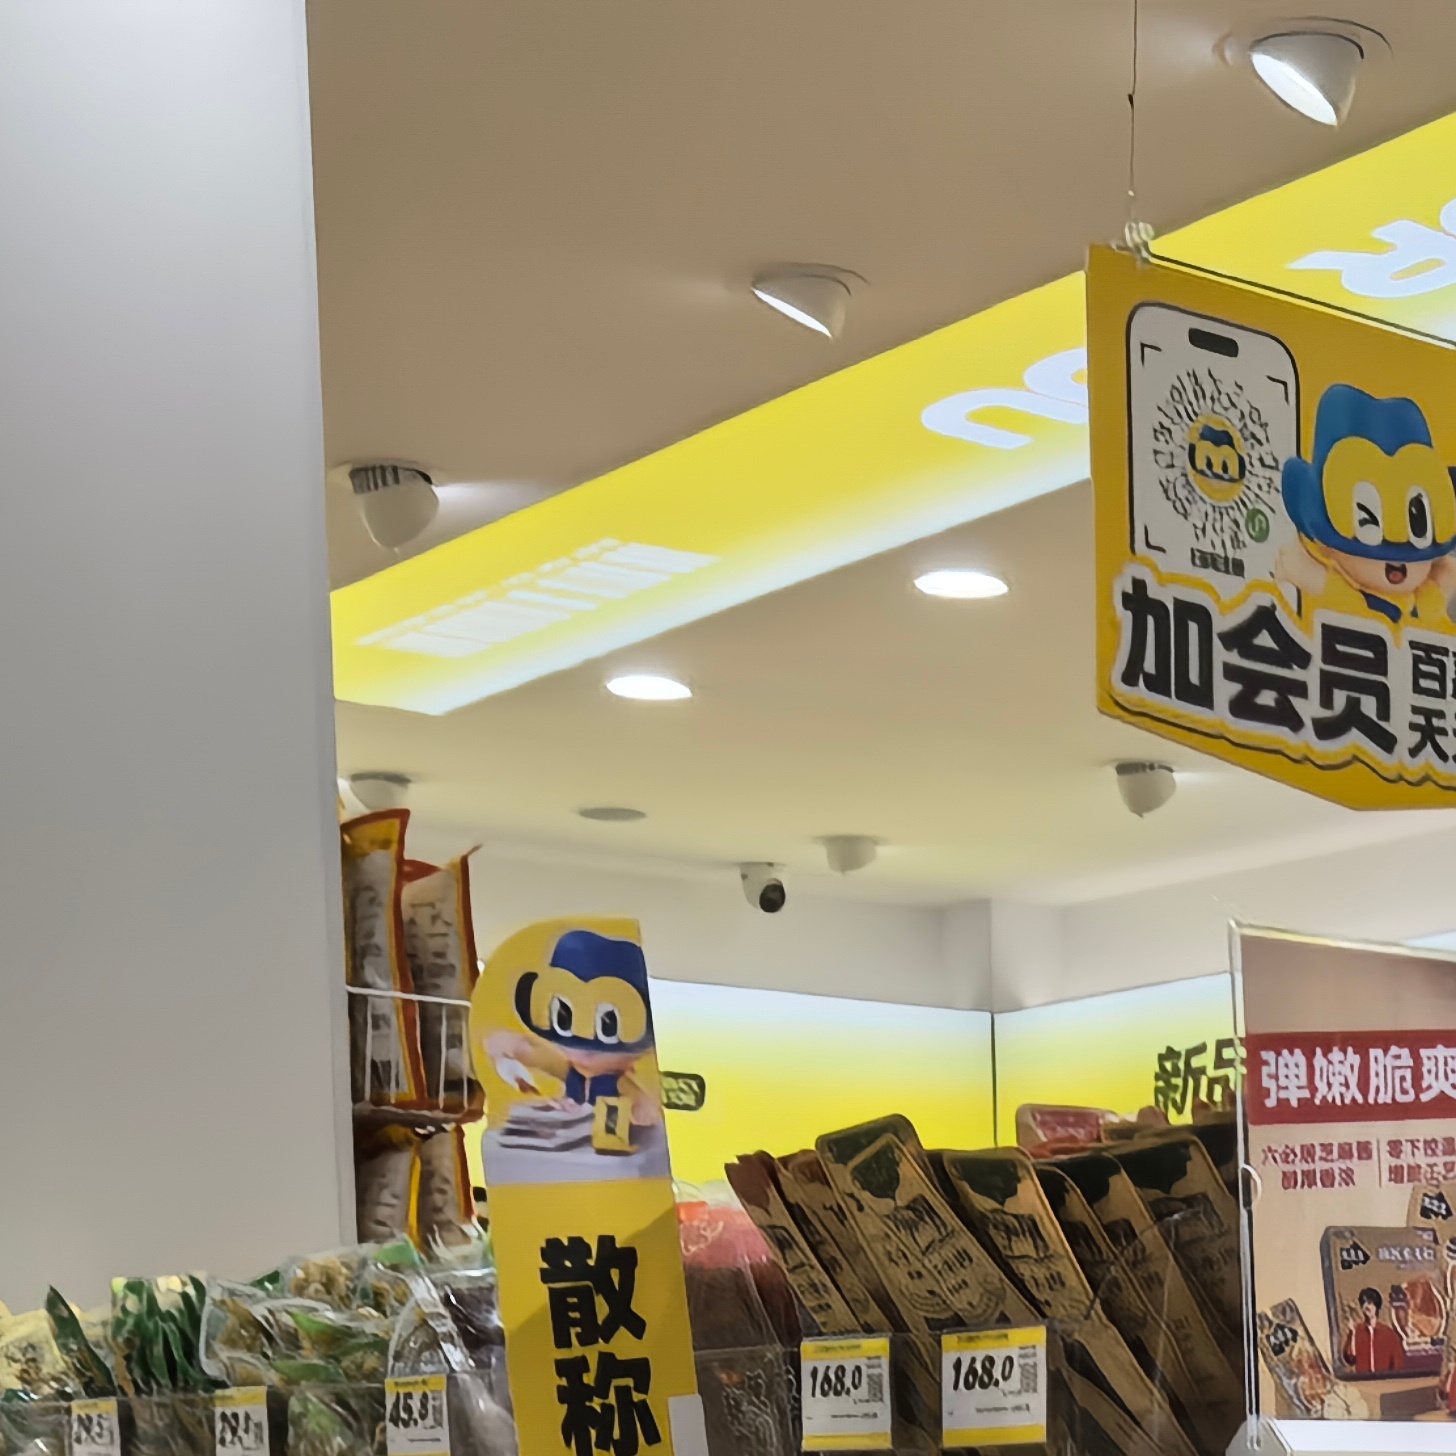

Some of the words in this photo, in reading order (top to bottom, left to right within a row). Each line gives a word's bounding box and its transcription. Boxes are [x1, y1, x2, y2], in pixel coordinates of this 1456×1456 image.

[1121, 580, 1397, 754] 加会员
[809, 1364, 863, 1400] 168.0
[952, 1354, 1015, 1392] 168.0
